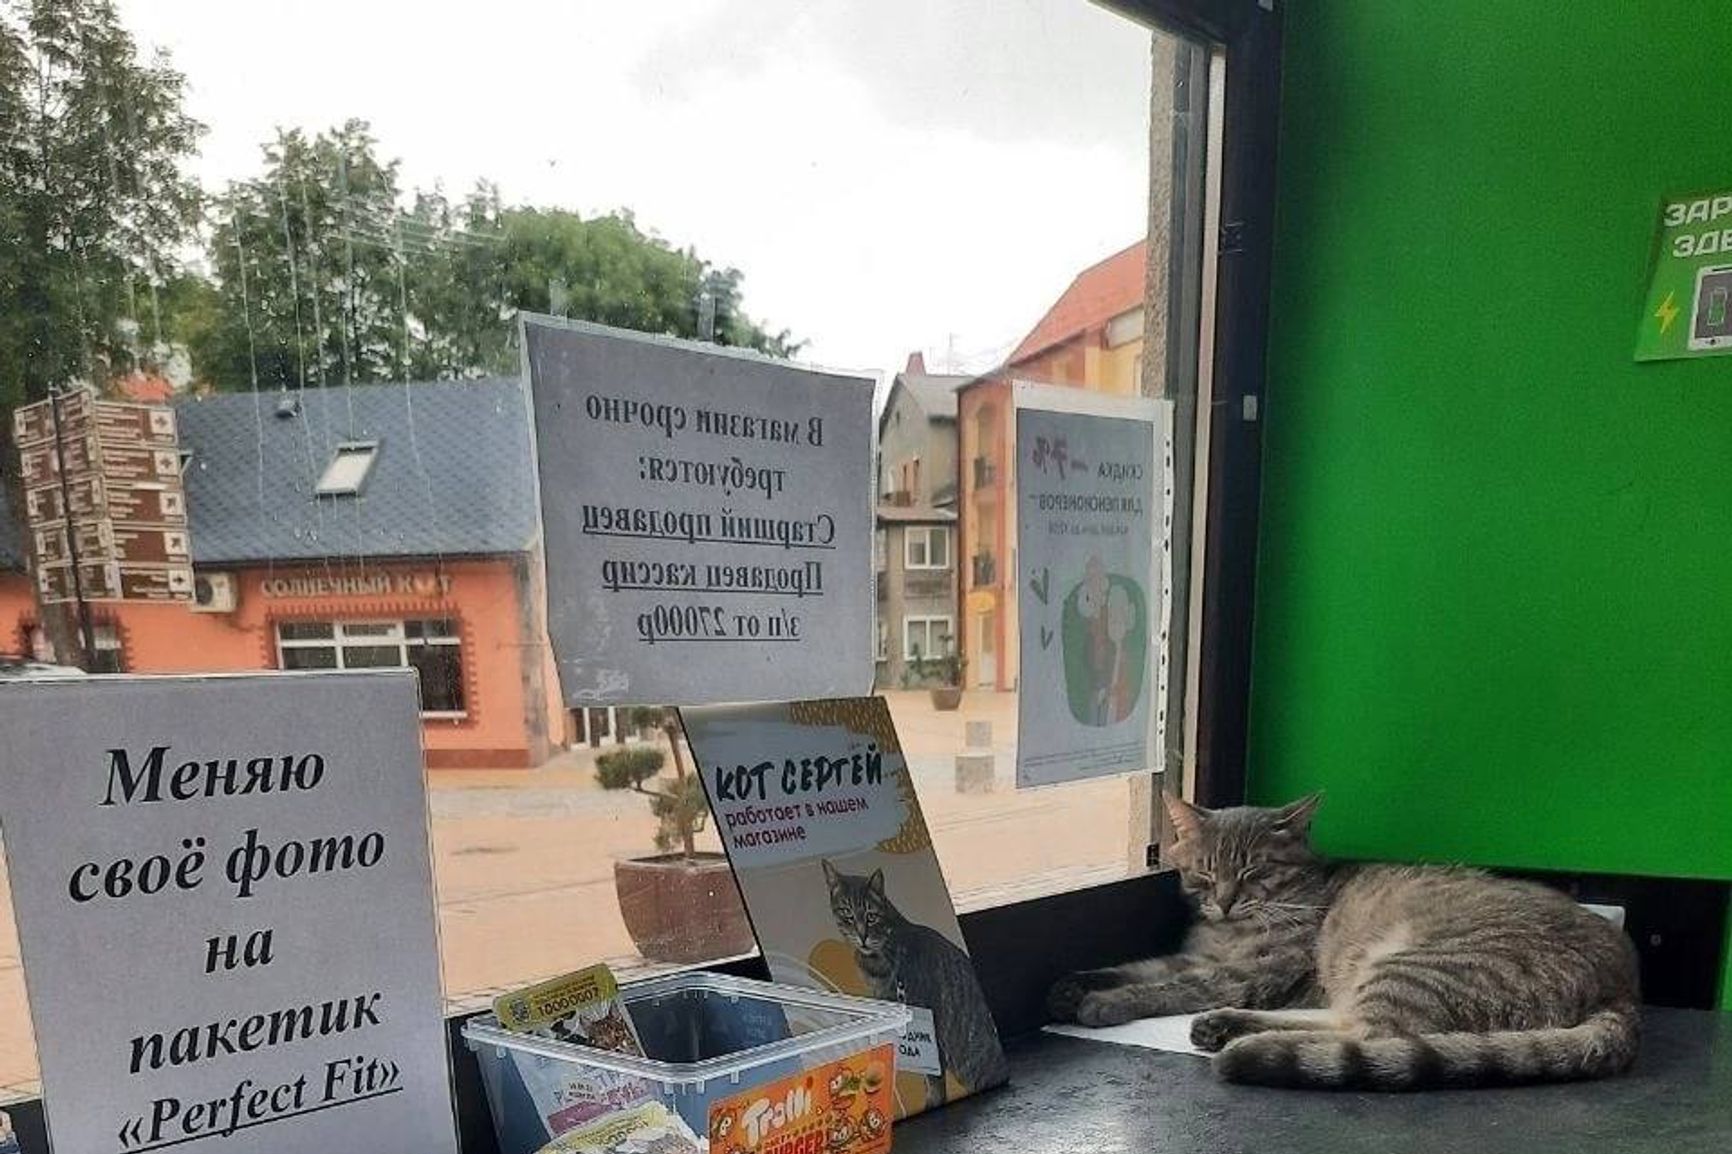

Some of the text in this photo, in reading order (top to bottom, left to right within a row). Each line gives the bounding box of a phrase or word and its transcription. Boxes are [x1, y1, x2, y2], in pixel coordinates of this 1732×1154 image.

[101, 745, 325, 806] Меняю
[716, 743, 882, 801] КОТ СЕРГЕЙ
[725, 798, 869, 831] работает в нашем
[734, 825, 807, 850] магазине
[69, 829, 385, 901] своё фото
[205, 927, 273, 974] на
[129, 991, 381, 1075] пакетик
[118, 1055, 402, 1152] «Perfect Fit»
[742, 1077, 814, 1147] Trolli
